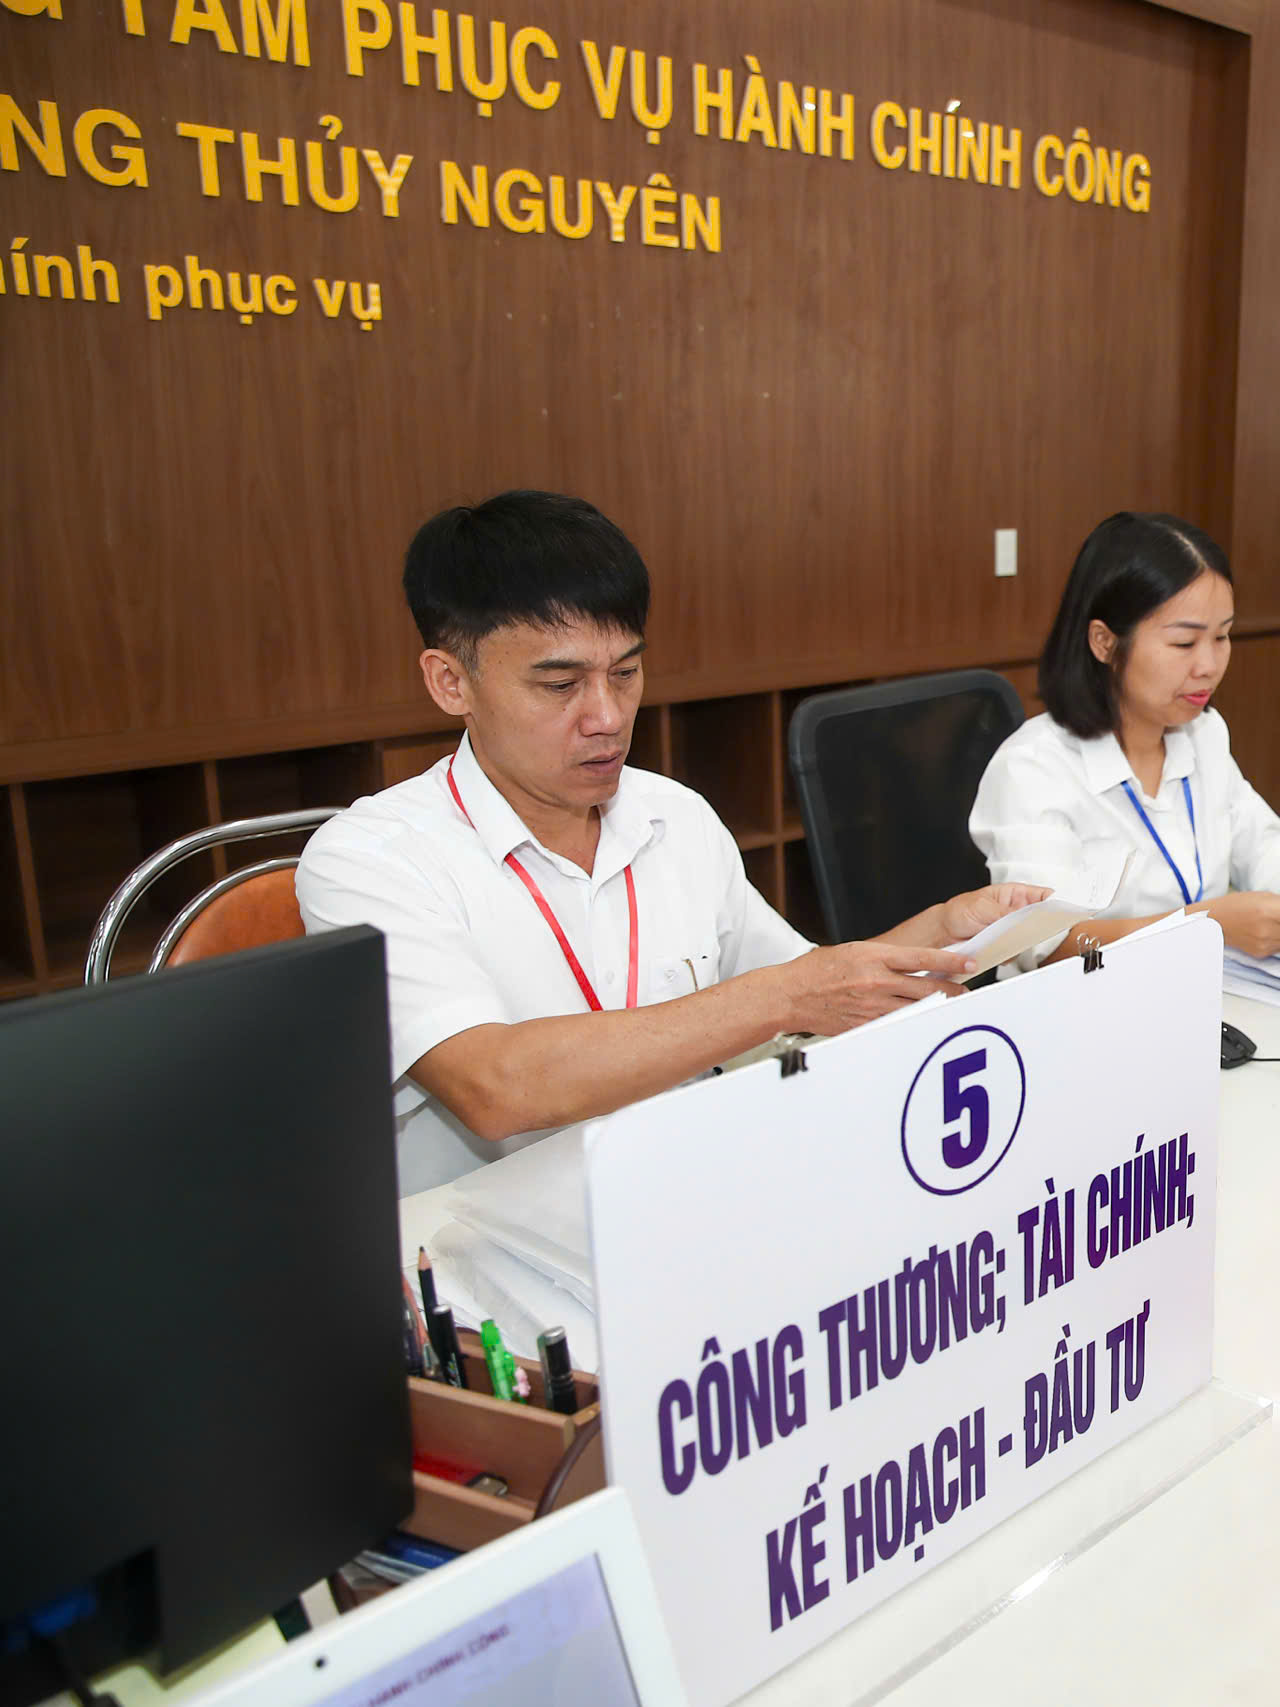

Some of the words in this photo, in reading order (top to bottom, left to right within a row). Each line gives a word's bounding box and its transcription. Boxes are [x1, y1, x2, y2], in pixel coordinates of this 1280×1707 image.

[176, 113, 414, 218] THỦY
[441, 159, 722, 253] NGUYÊN
[343, 0, 562, 118] PHỤC
[582, 39, 674, 145] VỤ
[694, 55, 856, 161] HÀNH
[873, 99, 1024, 190] CHÍNH
[1034, 127, 1152, 213] CÔNG
[0, 236, 120, 303] ính
[144, 255, 298, 325] phục
[314, 278, 383, 331] vụ
[942, 1048, 990, 1169] 5
[658, 1323, 807, 1496] CÔNG
[819, 1230, 1006, 1411] THƯƠNG;
[1017, 1177, 1075, 1305] TÀI
[1087, 1133, 1196, 1269] CHÍNH;
[766, 1465, 831, 1632] KẾ
[843, 1407, 987, 1583] HOẠCH
[1023, 1324, 1096, 1469] ĐẦU
[1105, 1299, 1151, 1412] TƯ
